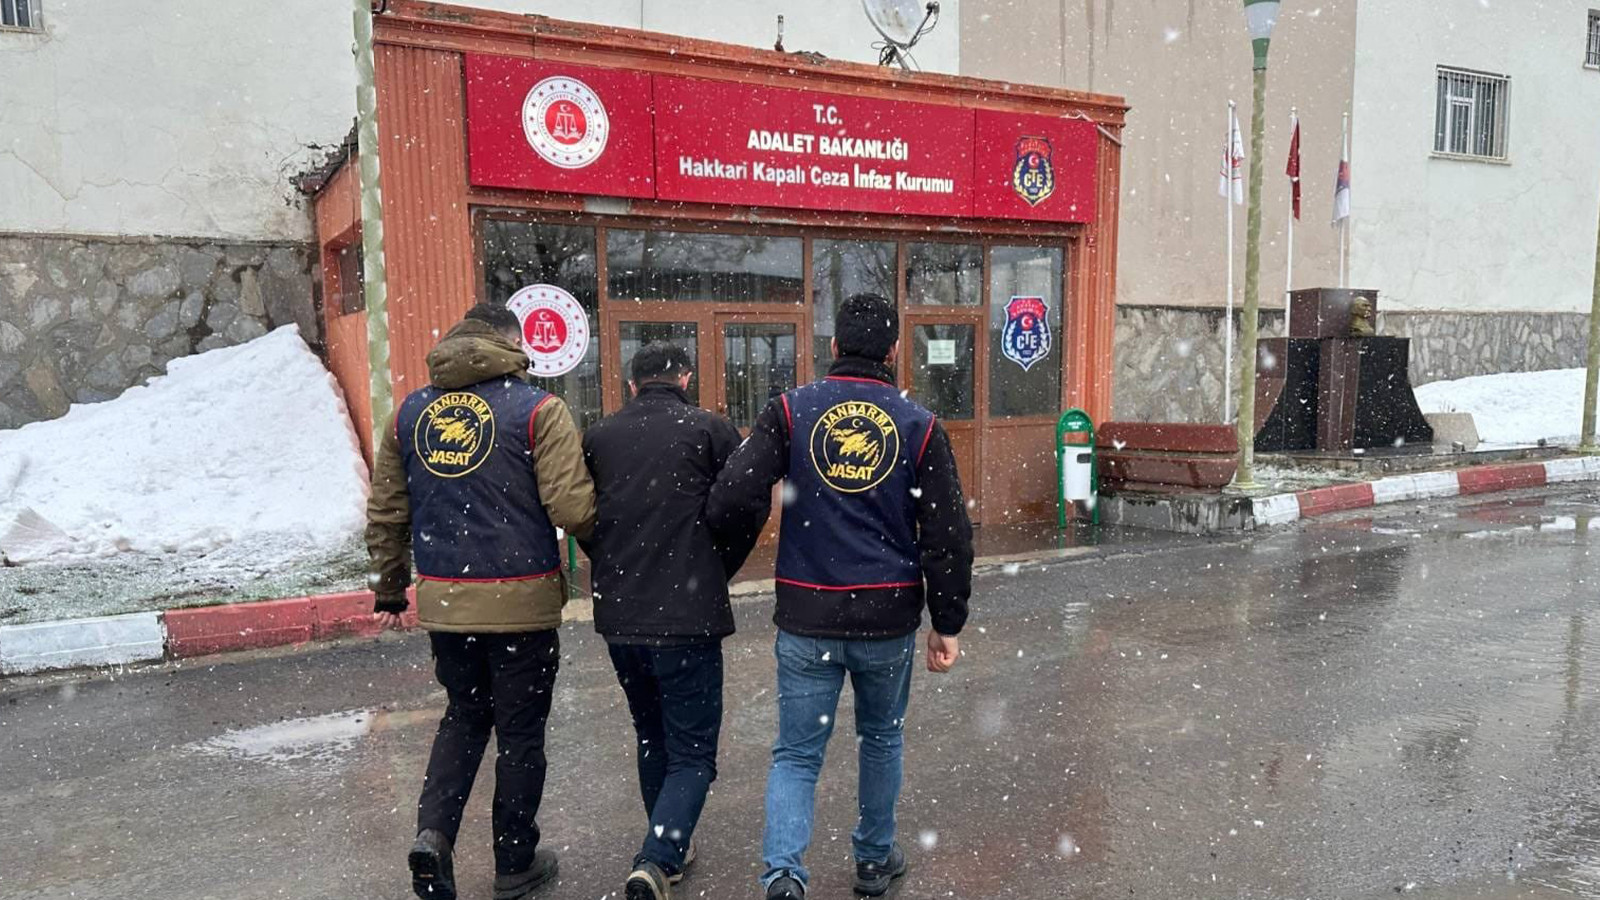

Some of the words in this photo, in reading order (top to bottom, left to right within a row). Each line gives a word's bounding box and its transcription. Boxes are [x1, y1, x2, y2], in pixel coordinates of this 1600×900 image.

[813, 104, 842, 125] T.C.
[747, 129, 814, 154] ADALET
[819, 136, 908, 161] BAKANLIĞI
[679, 156, 747, 180] Hakkari
[753, 161, 805, 186] Kapalı
[810, 165, 849, 187] Ceza
[854, 163, 892, 190] İnfaz
[896, 171, 953, 193] Kurumu
[427, 395, 490, 424] JANDARMA
[823, 404, 893, 436] JANDARMA
[428, 449, 471, 466] JASAT
[827, 463, 876, 481] JASAT
